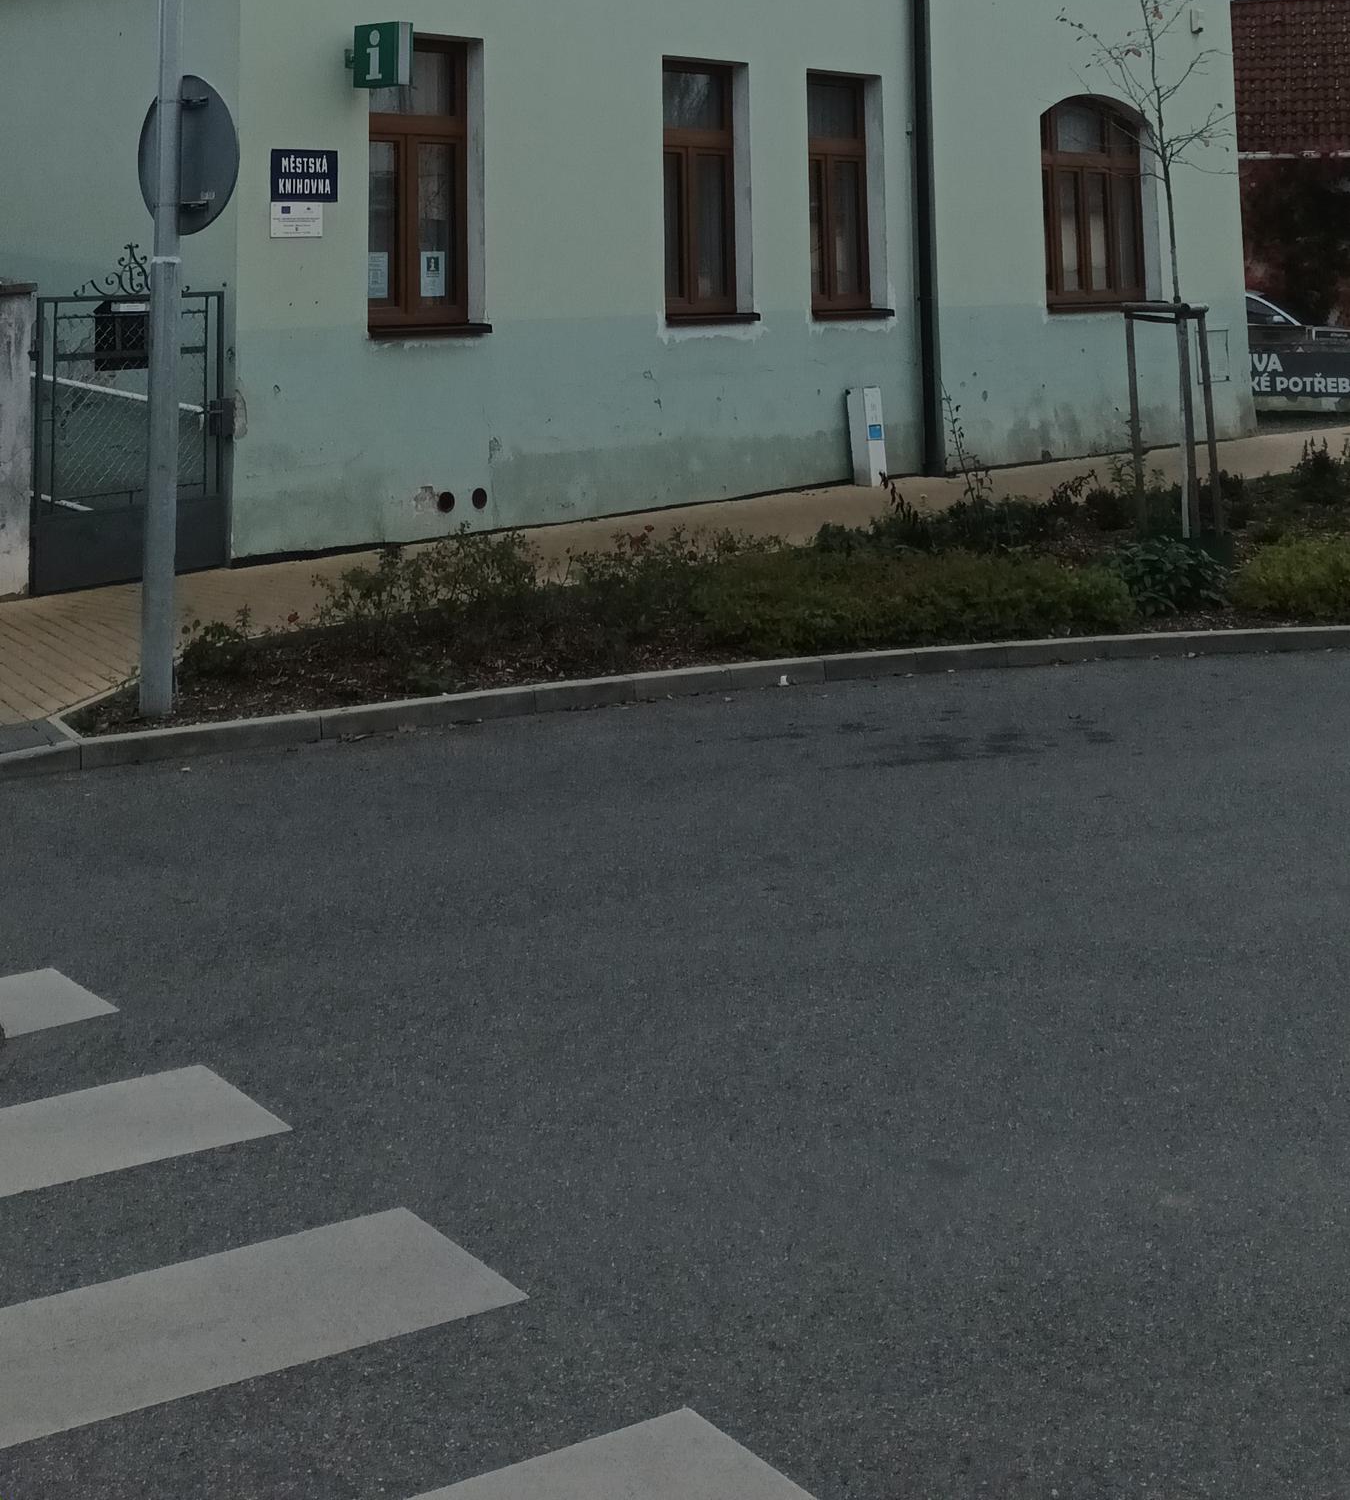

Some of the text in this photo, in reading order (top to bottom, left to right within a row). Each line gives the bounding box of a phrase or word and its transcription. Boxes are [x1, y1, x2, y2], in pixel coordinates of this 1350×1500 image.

[281, 155, 328, 173] MĚSTSKÁ
[278, 178, 331, 194] KNIHOVNA
[1275, 372, 1350, 393] POTŘEB
